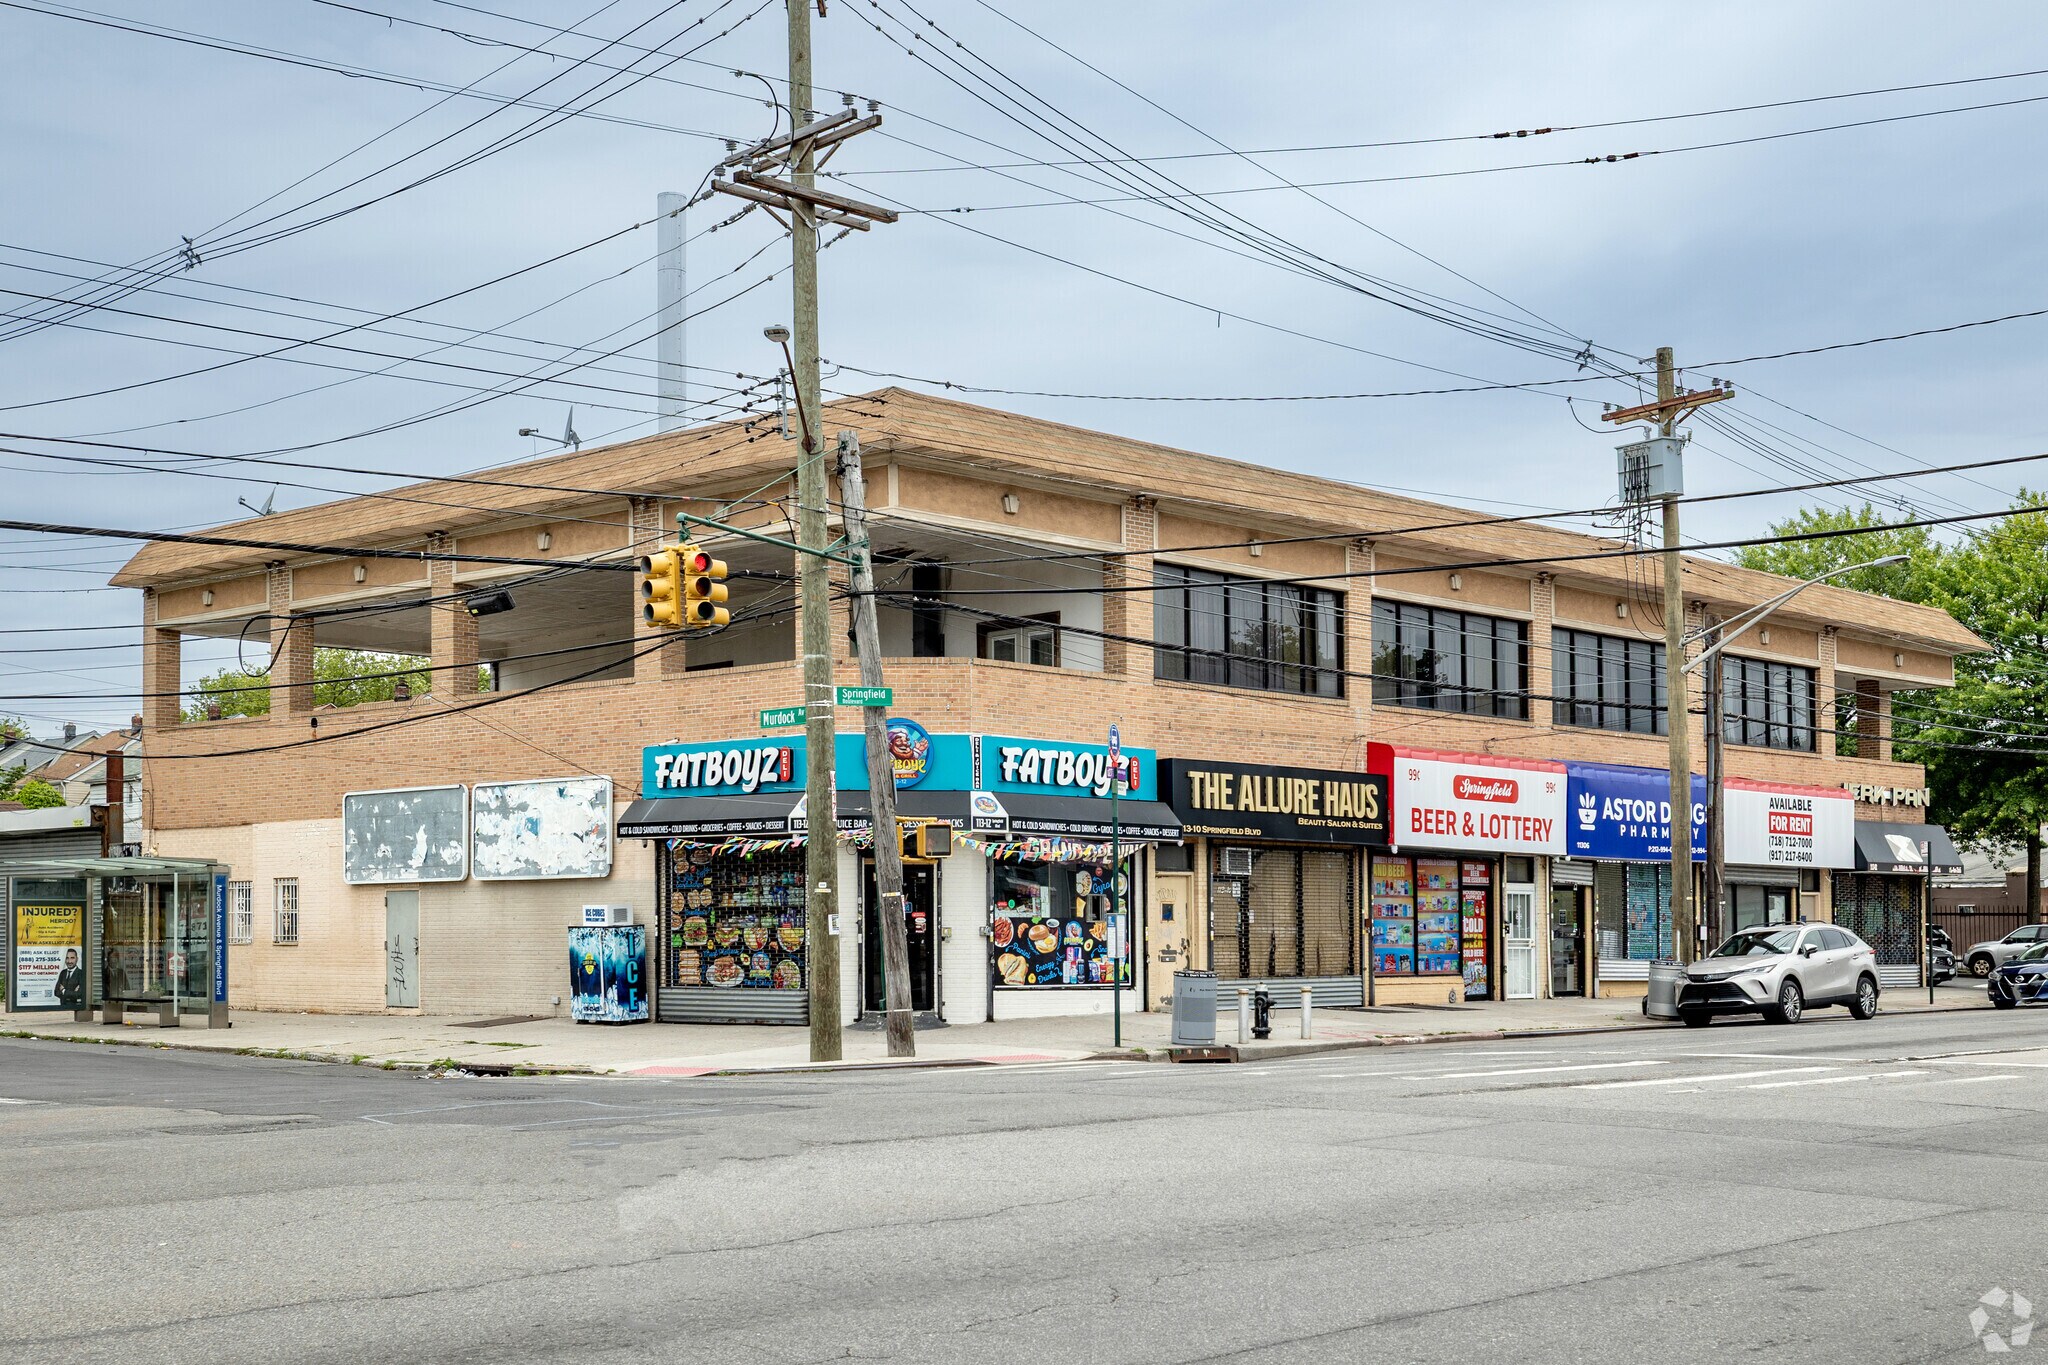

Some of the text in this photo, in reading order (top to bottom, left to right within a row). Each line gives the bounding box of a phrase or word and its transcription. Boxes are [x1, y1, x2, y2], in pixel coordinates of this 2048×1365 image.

[842, 688, 886, 701] Springfield
[763, 710, 796, 726] Murdock
[654, 746, 780, 793] FATBOYZ
[1408, 768, 1421, 781] 99¢
[1188, 770, 1379, 820] THE ALLURE HAUS
[1460, 778, 1513, 801] Springfield
[1892, 786, 1931, 808] PAN
[1602, 797, 1657, 823] ASTOR
[1769, 797, 1812, 811] AVAILABLE
[619, 827, 628, 835] HOT
[632, 826, 643, 834] COLD
[643, 825, 669, 834] SANDWICHES
[671, 824, 682, 833] COLD
[682, 824, 698, 832] DRINKS
[701, 823, 724, 832] GROCERIES
[726, 822, 743, 831] COFFEE
[745, 822, 763, 830] SNACKS
[765, 821, 785, 830] DESSERT
[836, 819, 868, 829] UICE BAR
[975, 818, 992, 828] 113-12
[1012, 820, 1022, 829] HOT
[1022, 820, 1027, 830] &
[1027, 821, 1039, 830] COLD
[1039, 822, 1067, 832] SANDWICHES
[1069, 824, 1081, 832] COLD
[1081, 824, 1098, 833] DRINKS
[1100, 825, 1123, 834] GROCES
[1125, 826, 1141, 835] COFFEE
[1143, 827, 1160, 836] SNACKS
[1162, 828, 1180, 837] DESSERT
[1411, 807, 1553, 842] BEER & LOTTERY
[1770, 815, 1812, 833] FOR RENT
[1620, 825, 1699, 839] PHARMY
[1769, 835, 1813, 848] (718) 712-7000
[1769, 849, 1813, 863] (917) 217-6400
[1374, 864, 1406, 877] AND BEER
[22, 907, 78, 917] INJURED?
[1463, 917, 1484, 933] COLD
[215, 945, 223, 979] Springfield
[625, 931, 641, 1014] ICE
